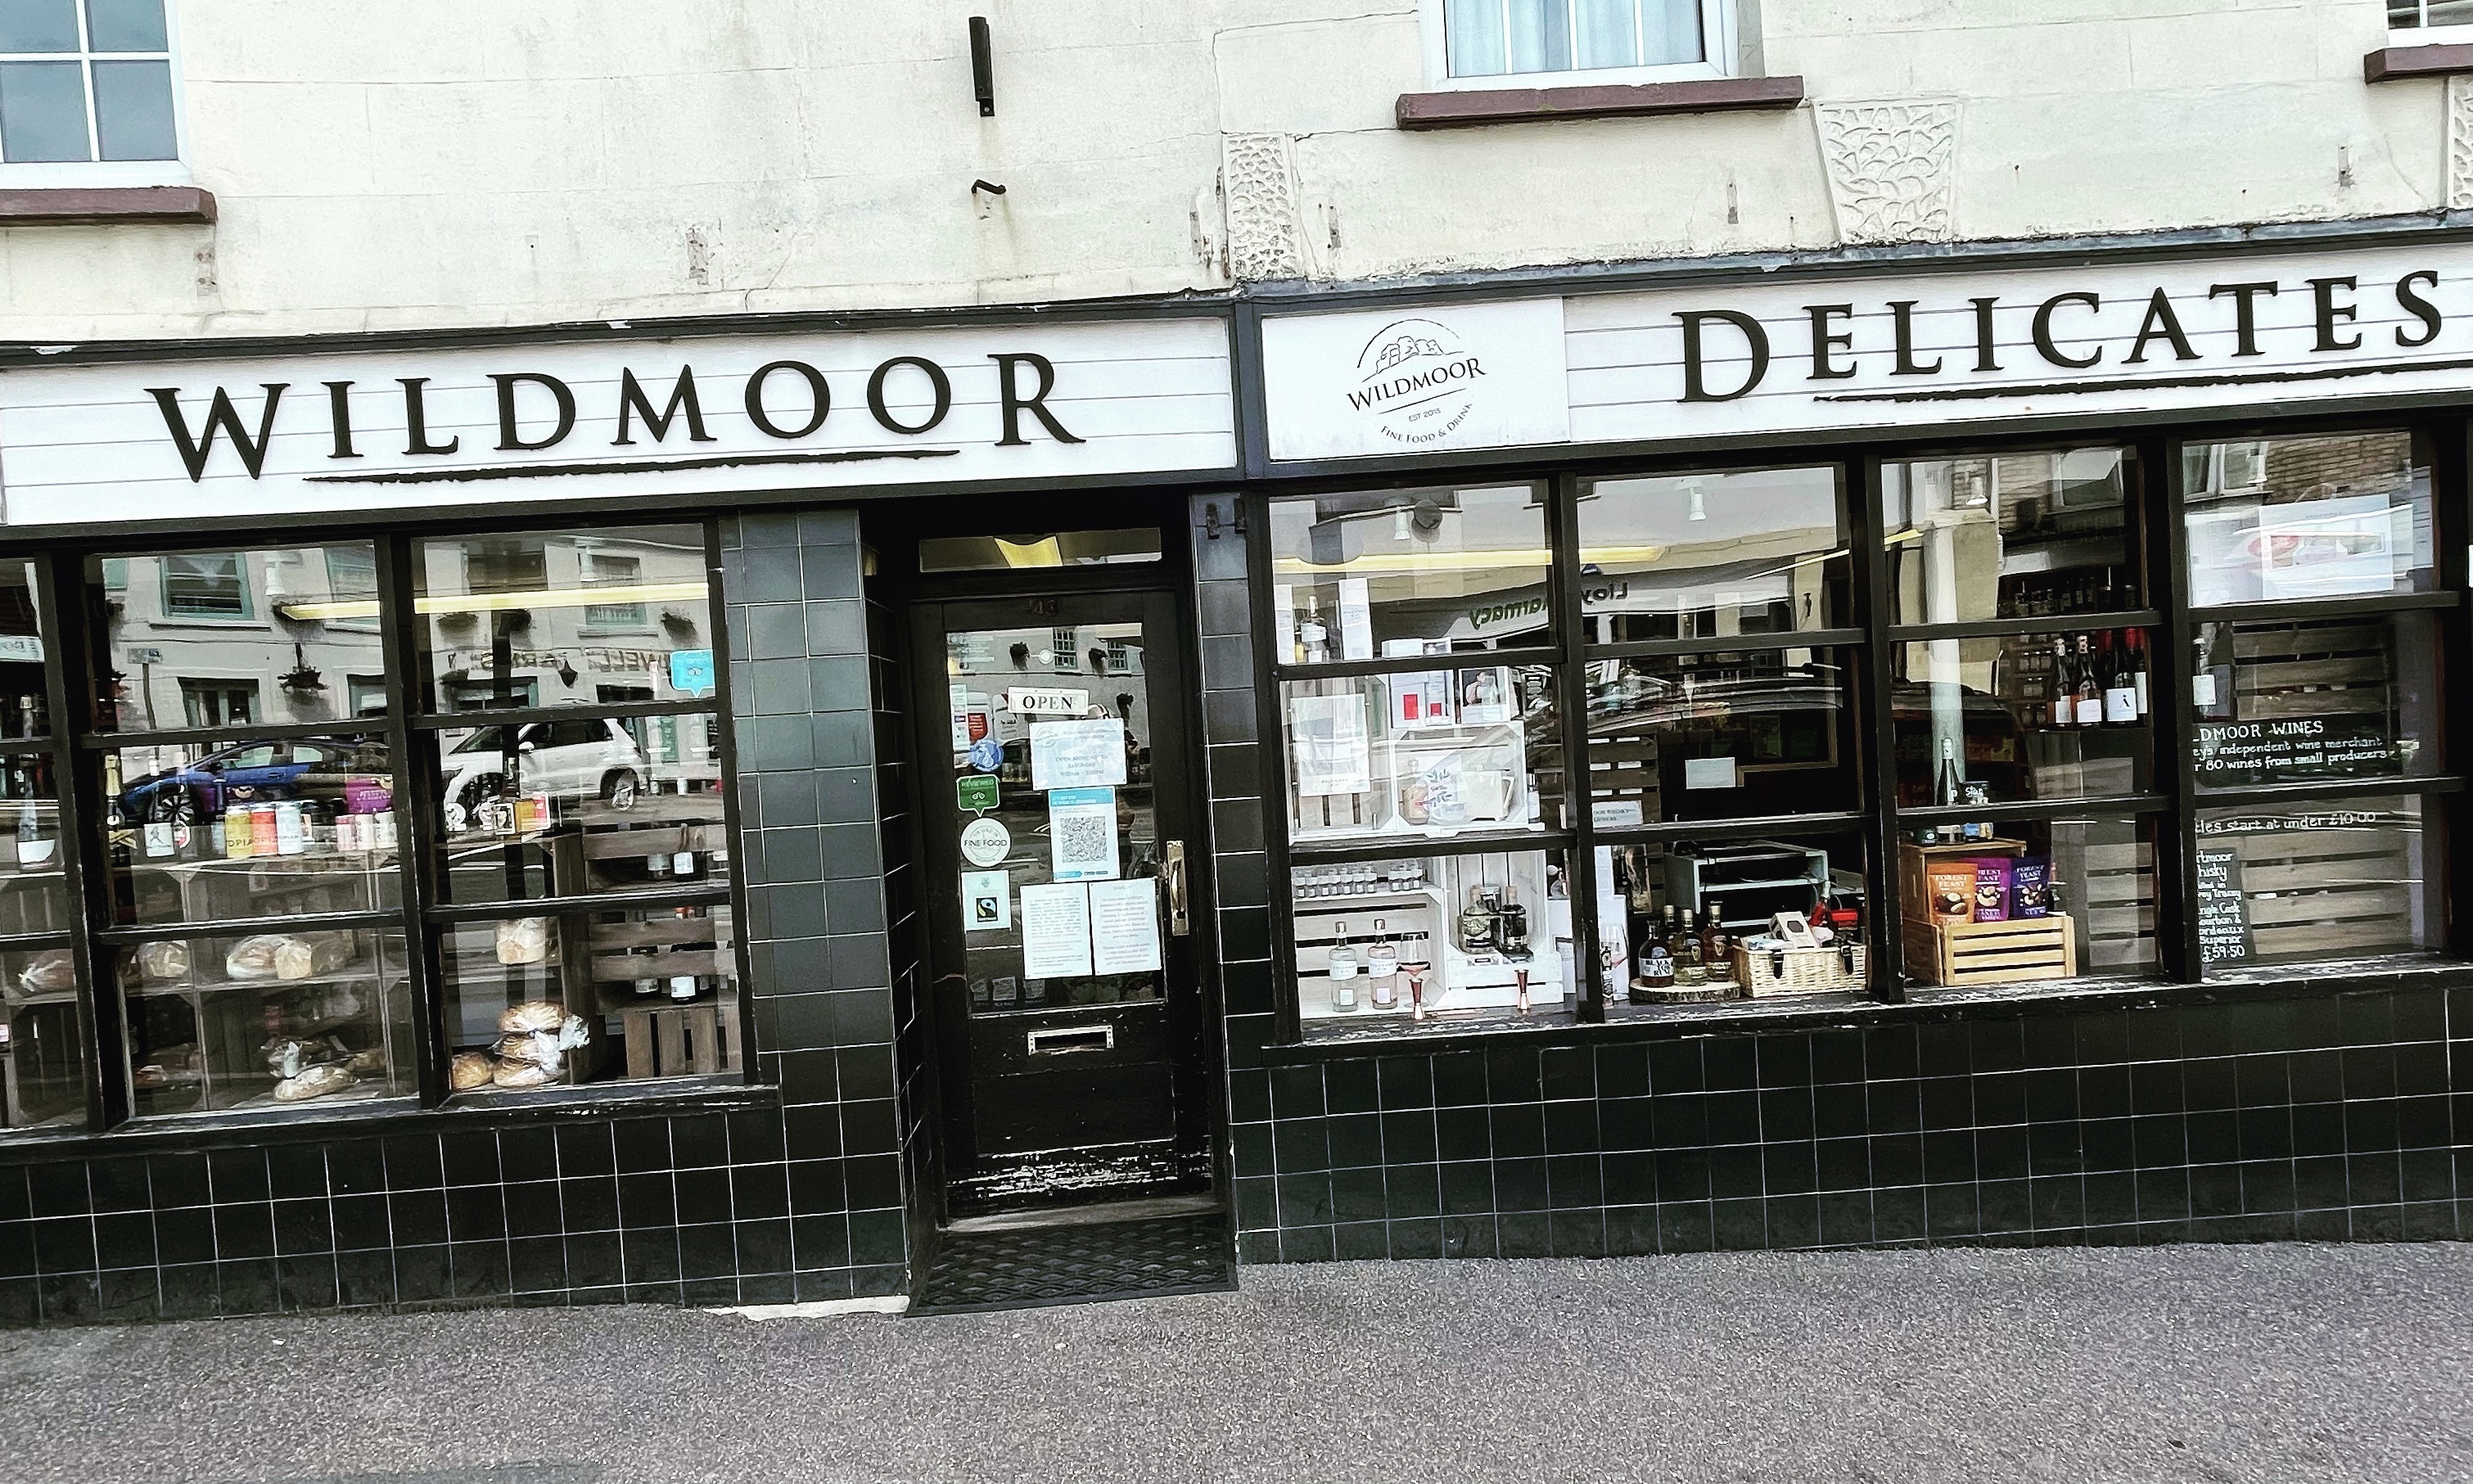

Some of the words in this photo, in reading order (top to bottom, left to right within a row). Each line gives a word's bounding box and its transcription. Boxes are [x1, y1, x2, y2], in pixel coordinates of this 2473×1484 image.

[1671, 270, 2442, 404] DELICATES
[1347, 358, 1487, 412] WILDMOOR
[142, 352, 1087, 483] WILDMOOR
[1408, 412, 1422, 422] EST
[1438, 428, 1446, 437] &
[1022, 695, 1073, 710] OPEN
[2193, 724, 2262, 742] DMOOR
[2271, 720, 2324, 735] WINES
[2219, 740, 2291, 757] independent
[2295, 741, 2322, 750] wine
[2325, 737, 2383, 748] merchant
[2205, 759, 2223, 771] 80
[2227, 758, 2263, 769] wines
[2265, 756, 2293, 769] from
[2295, 751, 2323, 765] small
[2327, 749, 2388, 766] producers
[2266, 819, 2281, 830] at
[2284, 815, 2326, 829] under
[963, 839, 981, 847] FINE
[982, 839, 1008, 847] FOOD
